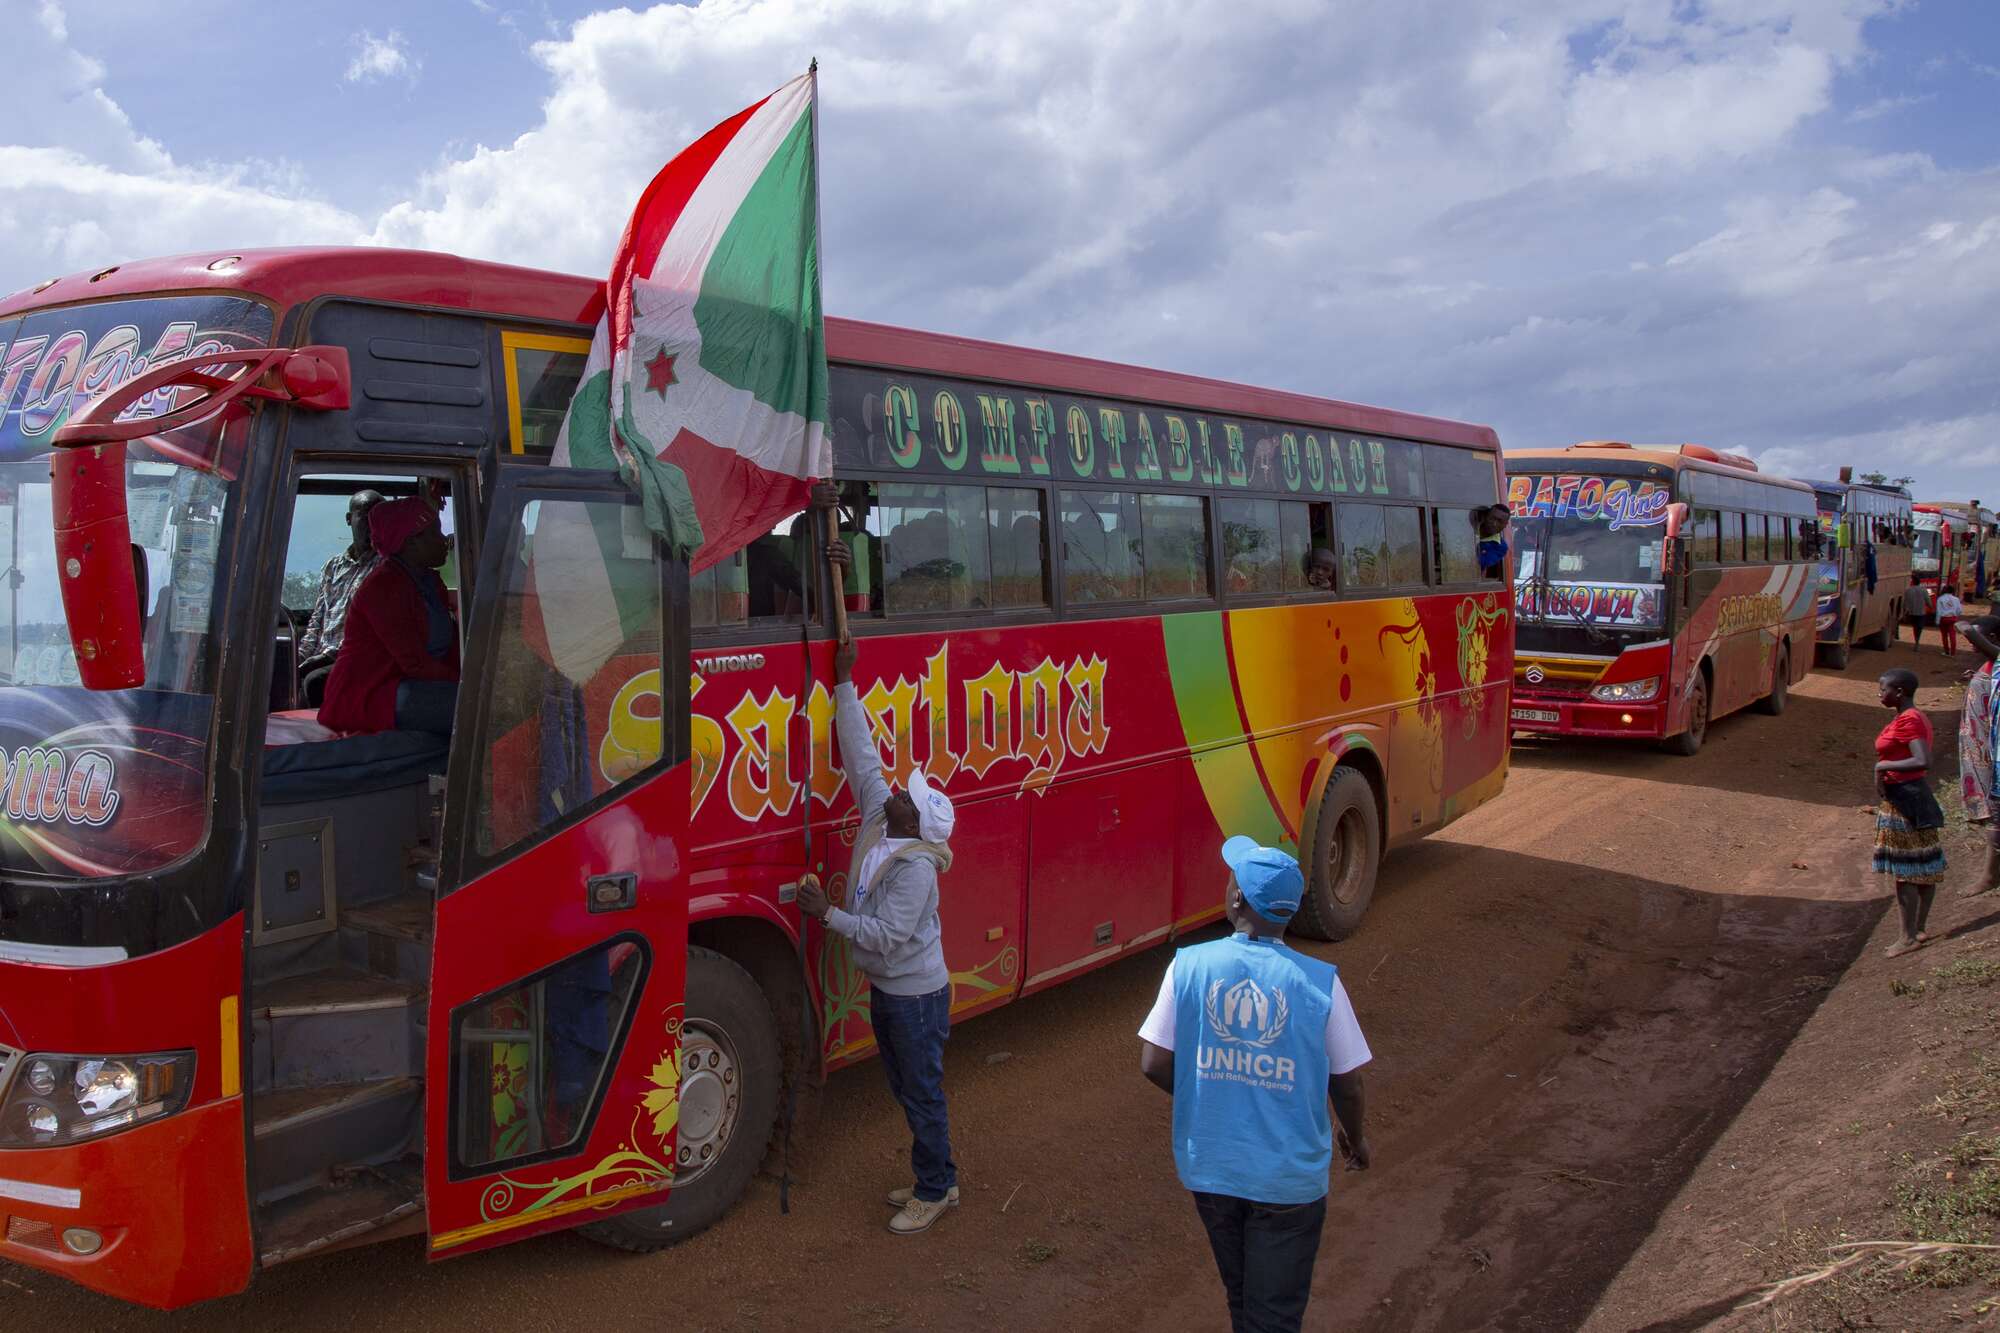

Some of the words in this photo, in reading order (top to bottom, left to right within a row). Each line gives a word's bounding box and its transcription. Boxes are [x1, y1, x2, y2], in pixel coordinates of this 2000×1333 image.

[884, 384, 1248, 487] COMFOTABLE
[1281, 431, 1389, 494] COACH
[1606, 490, 1669, 531] Line
[695, 653, 766, 674] YUTONG
[1196, 1046, 1295, 1082] UNHCR
[1258, 1079, 1294, 1093] Agency
